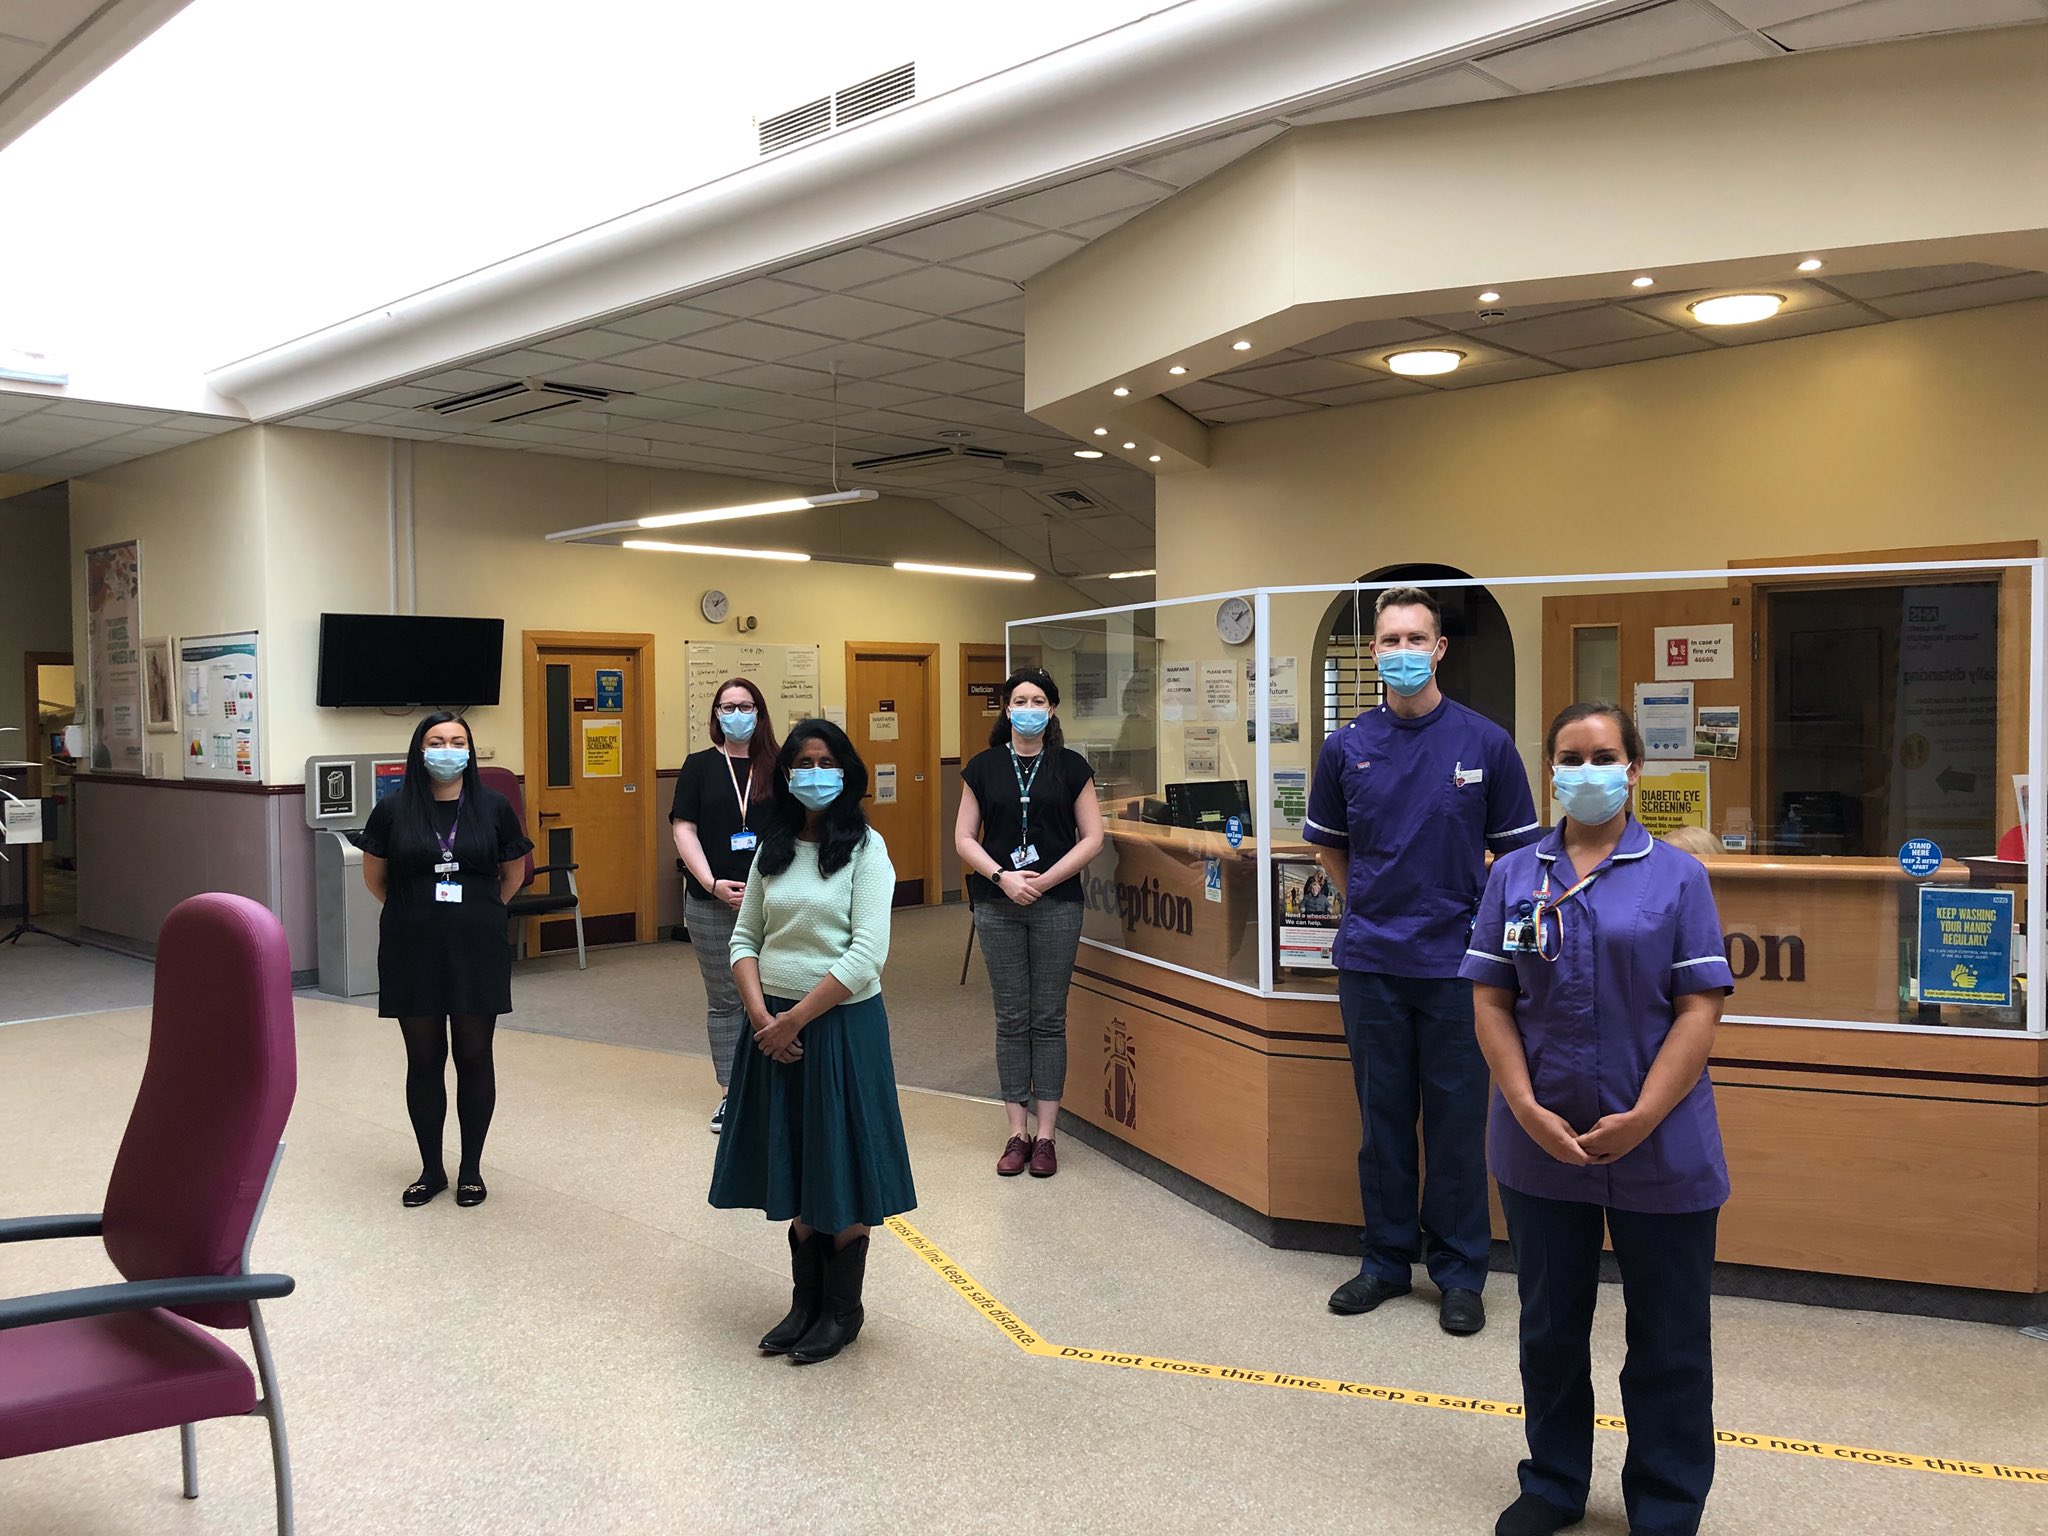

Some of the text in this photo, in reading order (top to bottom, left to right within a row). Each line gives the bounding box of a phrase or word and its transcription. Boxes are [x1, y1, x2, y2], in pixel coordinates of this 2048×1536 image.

[1642, 790, 1700, 801] DIABETIC EYE
[1642, 802, 1691, 812] SCREENING
[1936, 907, 1997, 921] KEEP WASHING
[1940, 920, 1992, 934] YOUR HANDS
[1943, 933, 1988, 946] REGULARLY
[890, 1220, 912, 1237] cross
[908, 1236, 928, 1250] this
[922, 1249, 943, 1265] line.
[940, 1265, 967, 1286] Keep
[968, 1292, 995, 1309] safe
[989, 1311, 1036, 1347] distance.
[1060, 1348, 1094, 1358] Do
[1100, 1354, 1144, 1366] not
[1150, 1361, 1211, 1374] cross
[1220, 1368, 1265, 1381] this
[1274, 1374, 1327, 1389] line.
[1338, 1383, 1405, 1400] Keep
[1439, 1397, 1496, 1412] safe
[1716, 1431, 2048, 1480] Do not cross this line
